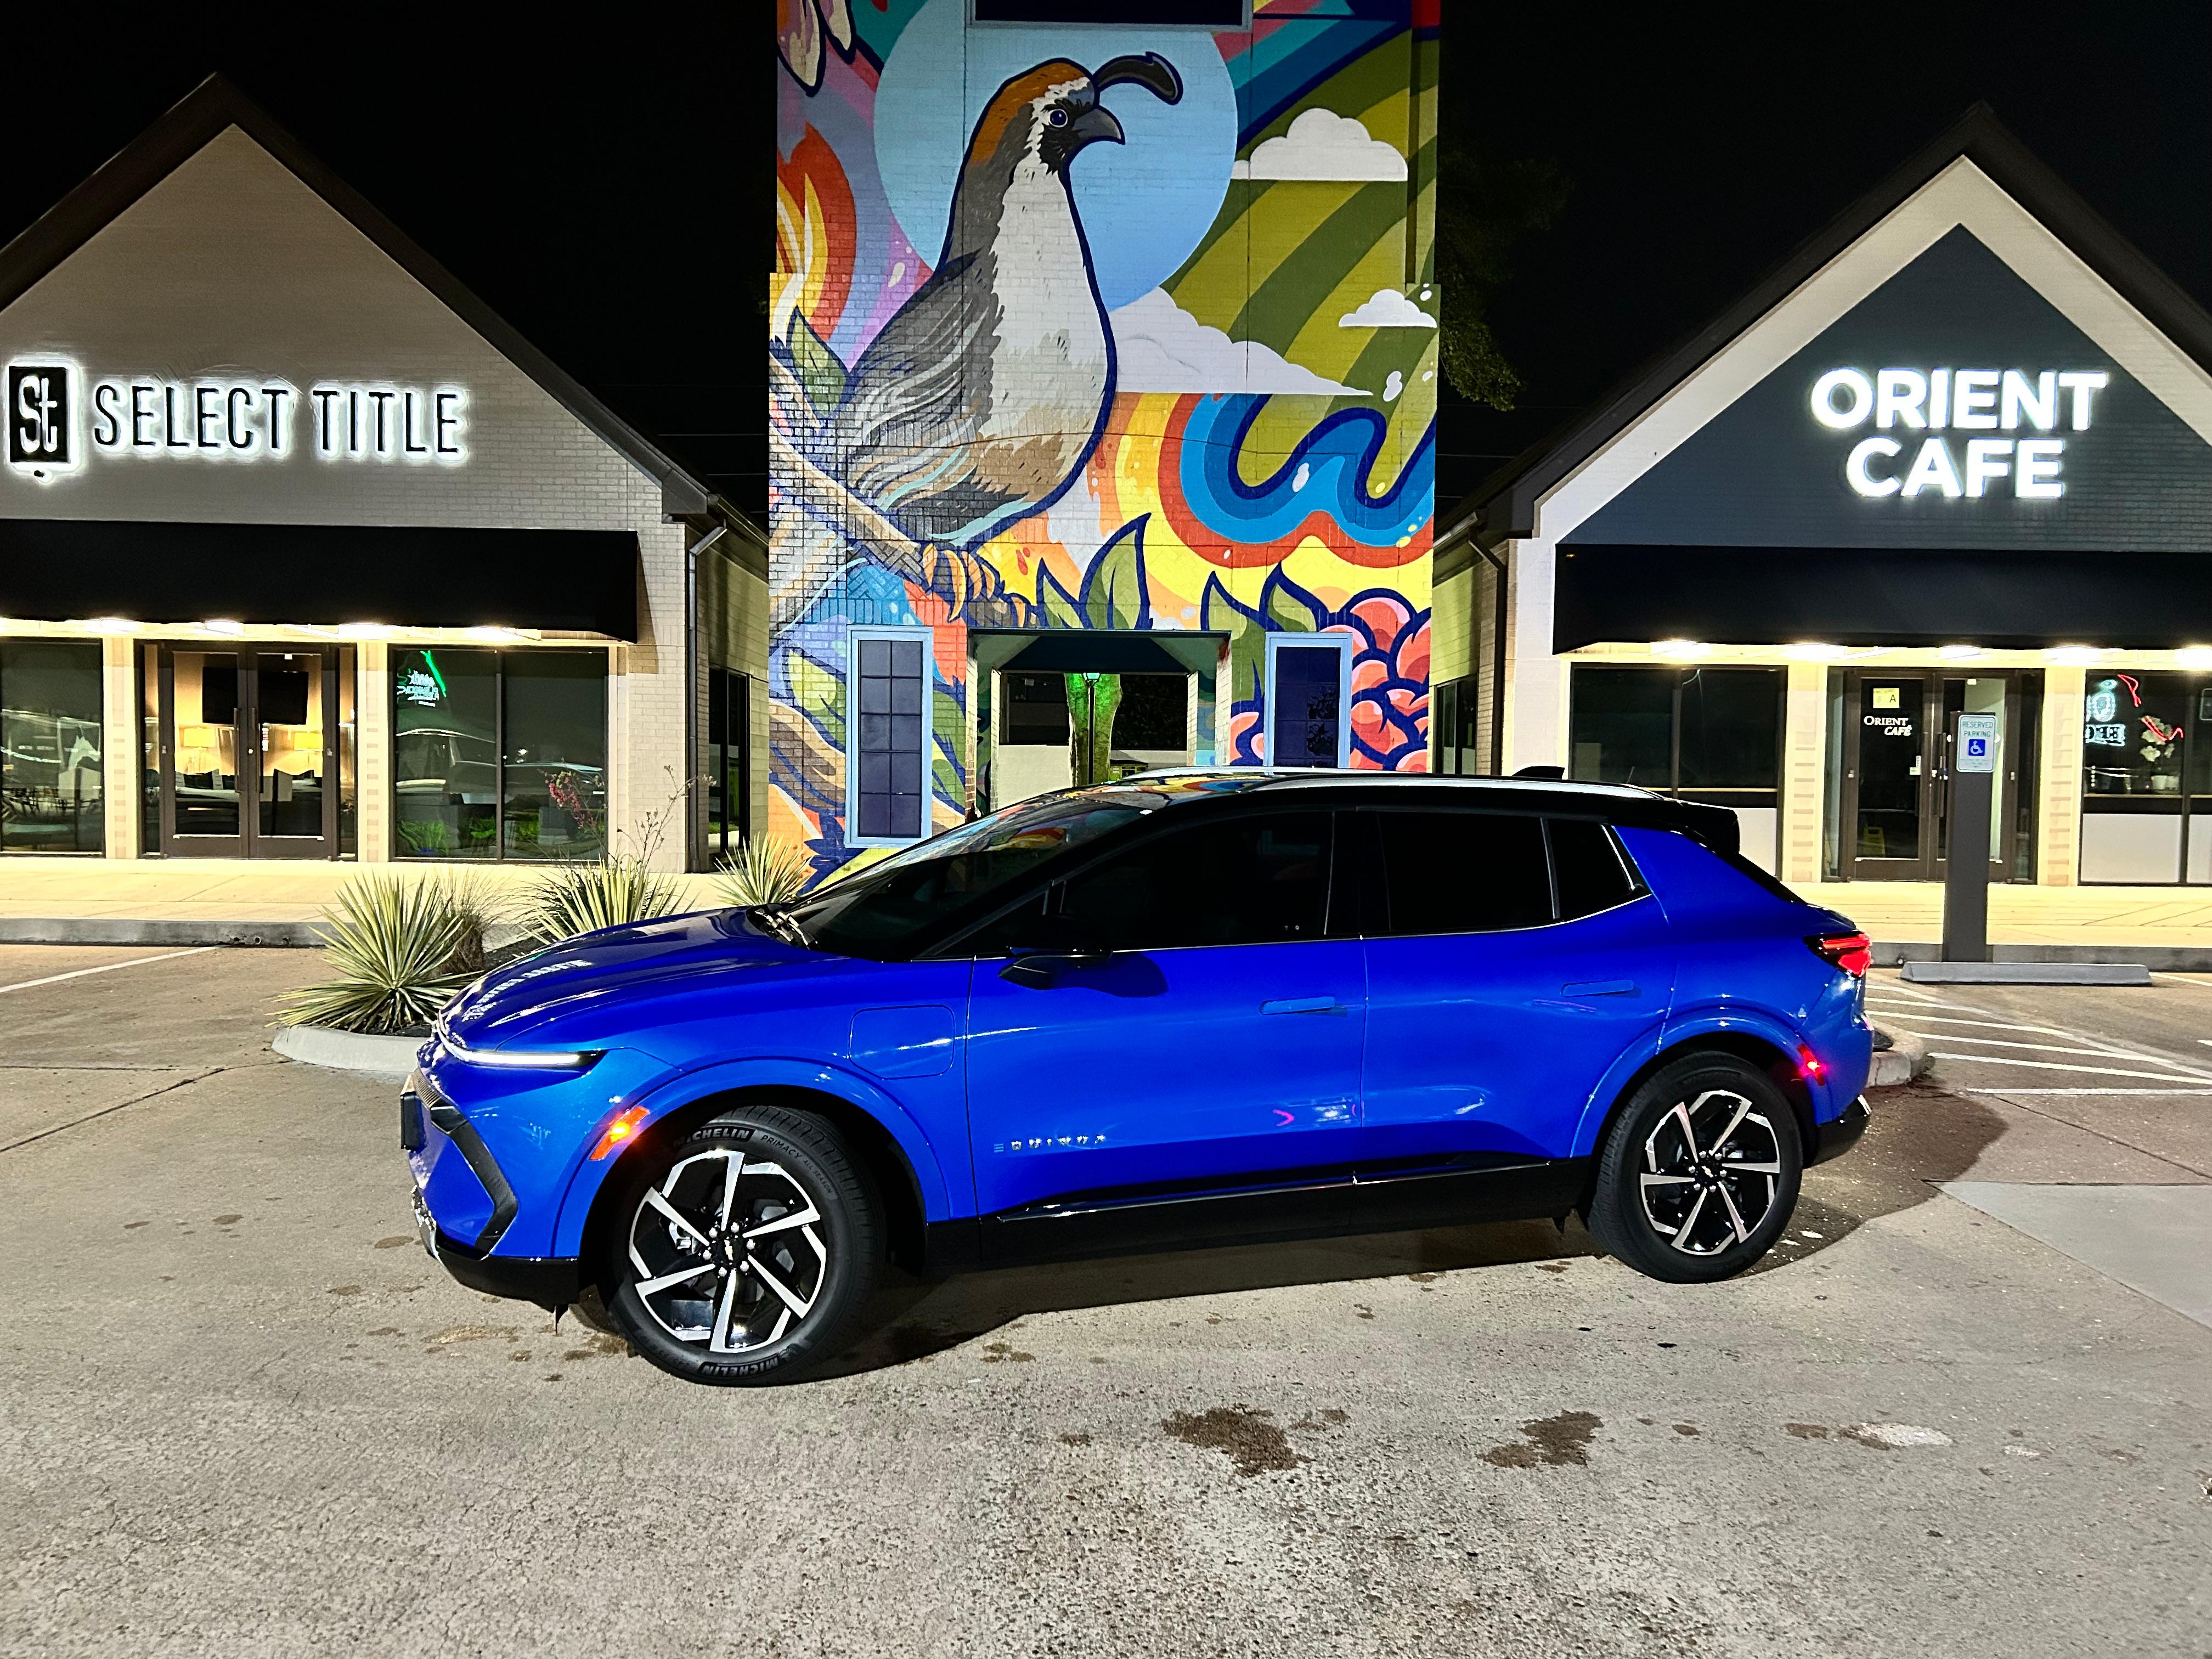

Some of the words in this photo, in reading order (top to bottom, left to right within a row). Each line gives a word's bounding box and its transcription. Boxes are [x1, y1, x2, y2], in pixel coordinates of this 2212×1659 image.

[1812, 367, 2107, 431] ORIENT
[94, 384, 289, 450] SELECT
[313, 390, 459, 453] TITLE
[1846, 436, 2065, 498] CAFE
[1889, 694, 1897, 703] A
[1864, 715, 1909, 726] ORIENT
[761, 1135, 803, 1158] PRIMACY
[701, 1356, 780, 1377] MICHELIN
